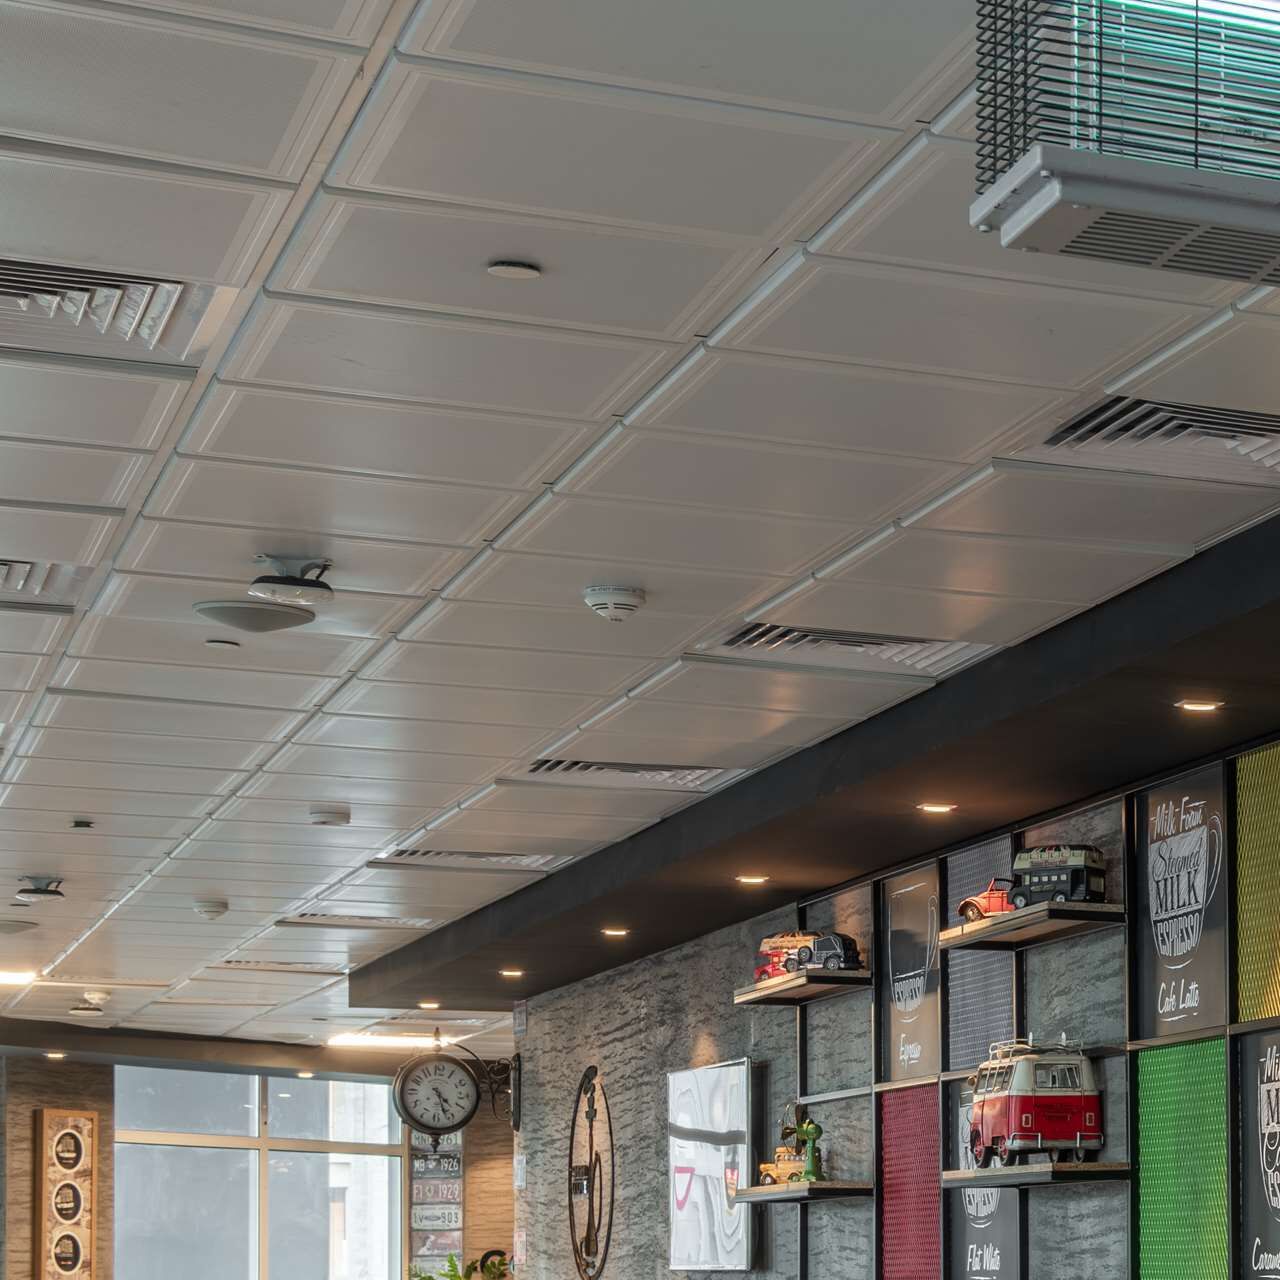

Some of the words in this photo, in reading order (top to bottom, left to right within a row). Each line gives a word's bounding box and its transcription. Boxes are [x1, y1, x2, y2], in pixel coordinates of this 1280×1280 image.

[1154, 800, 1176, 839] Milk
[1180, 797, 1202, 833] Foam
[1152, 841, 1200, 878] Steamed
[1155, 869, 1200, 915] MILK
[1157, 912, 1200, 956] ESPRESSO
[1158, 982, 1176, 1014] Cafe
[1179, 979, 1200, 1009] Latte
[440, 1159, 459, 1171] 1926
[439, 1184, 459, 1199] 1929
[967, 1244, 983, 1271] Flat
